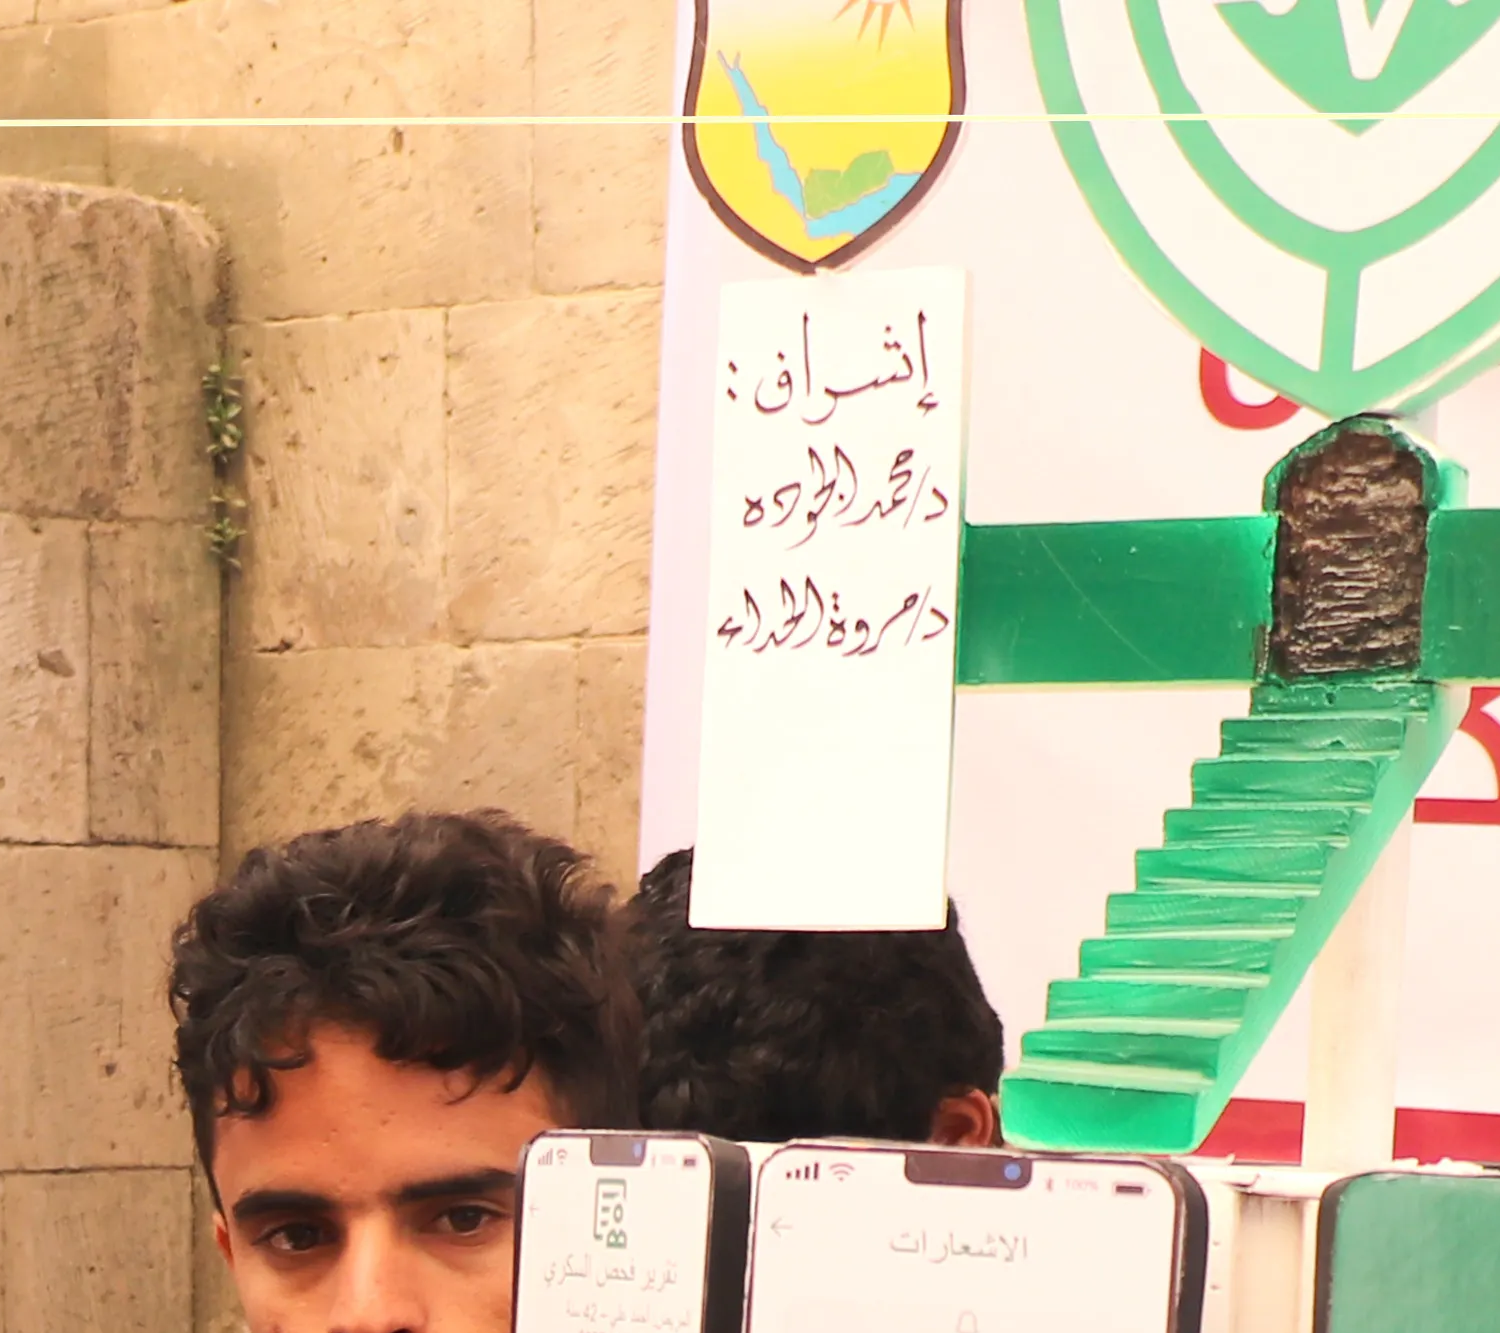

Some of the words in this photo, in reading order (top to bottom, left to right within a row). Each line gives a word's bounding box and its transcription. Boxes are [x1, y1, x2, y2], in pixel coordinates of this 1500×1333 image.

[754, 309, 939, 425] إشراف
[889, 1229, 1029, 1264] الاشعارات
[543, 1253, 592, 1287] السكري
[596, 1264, 636, 1290] فحص
